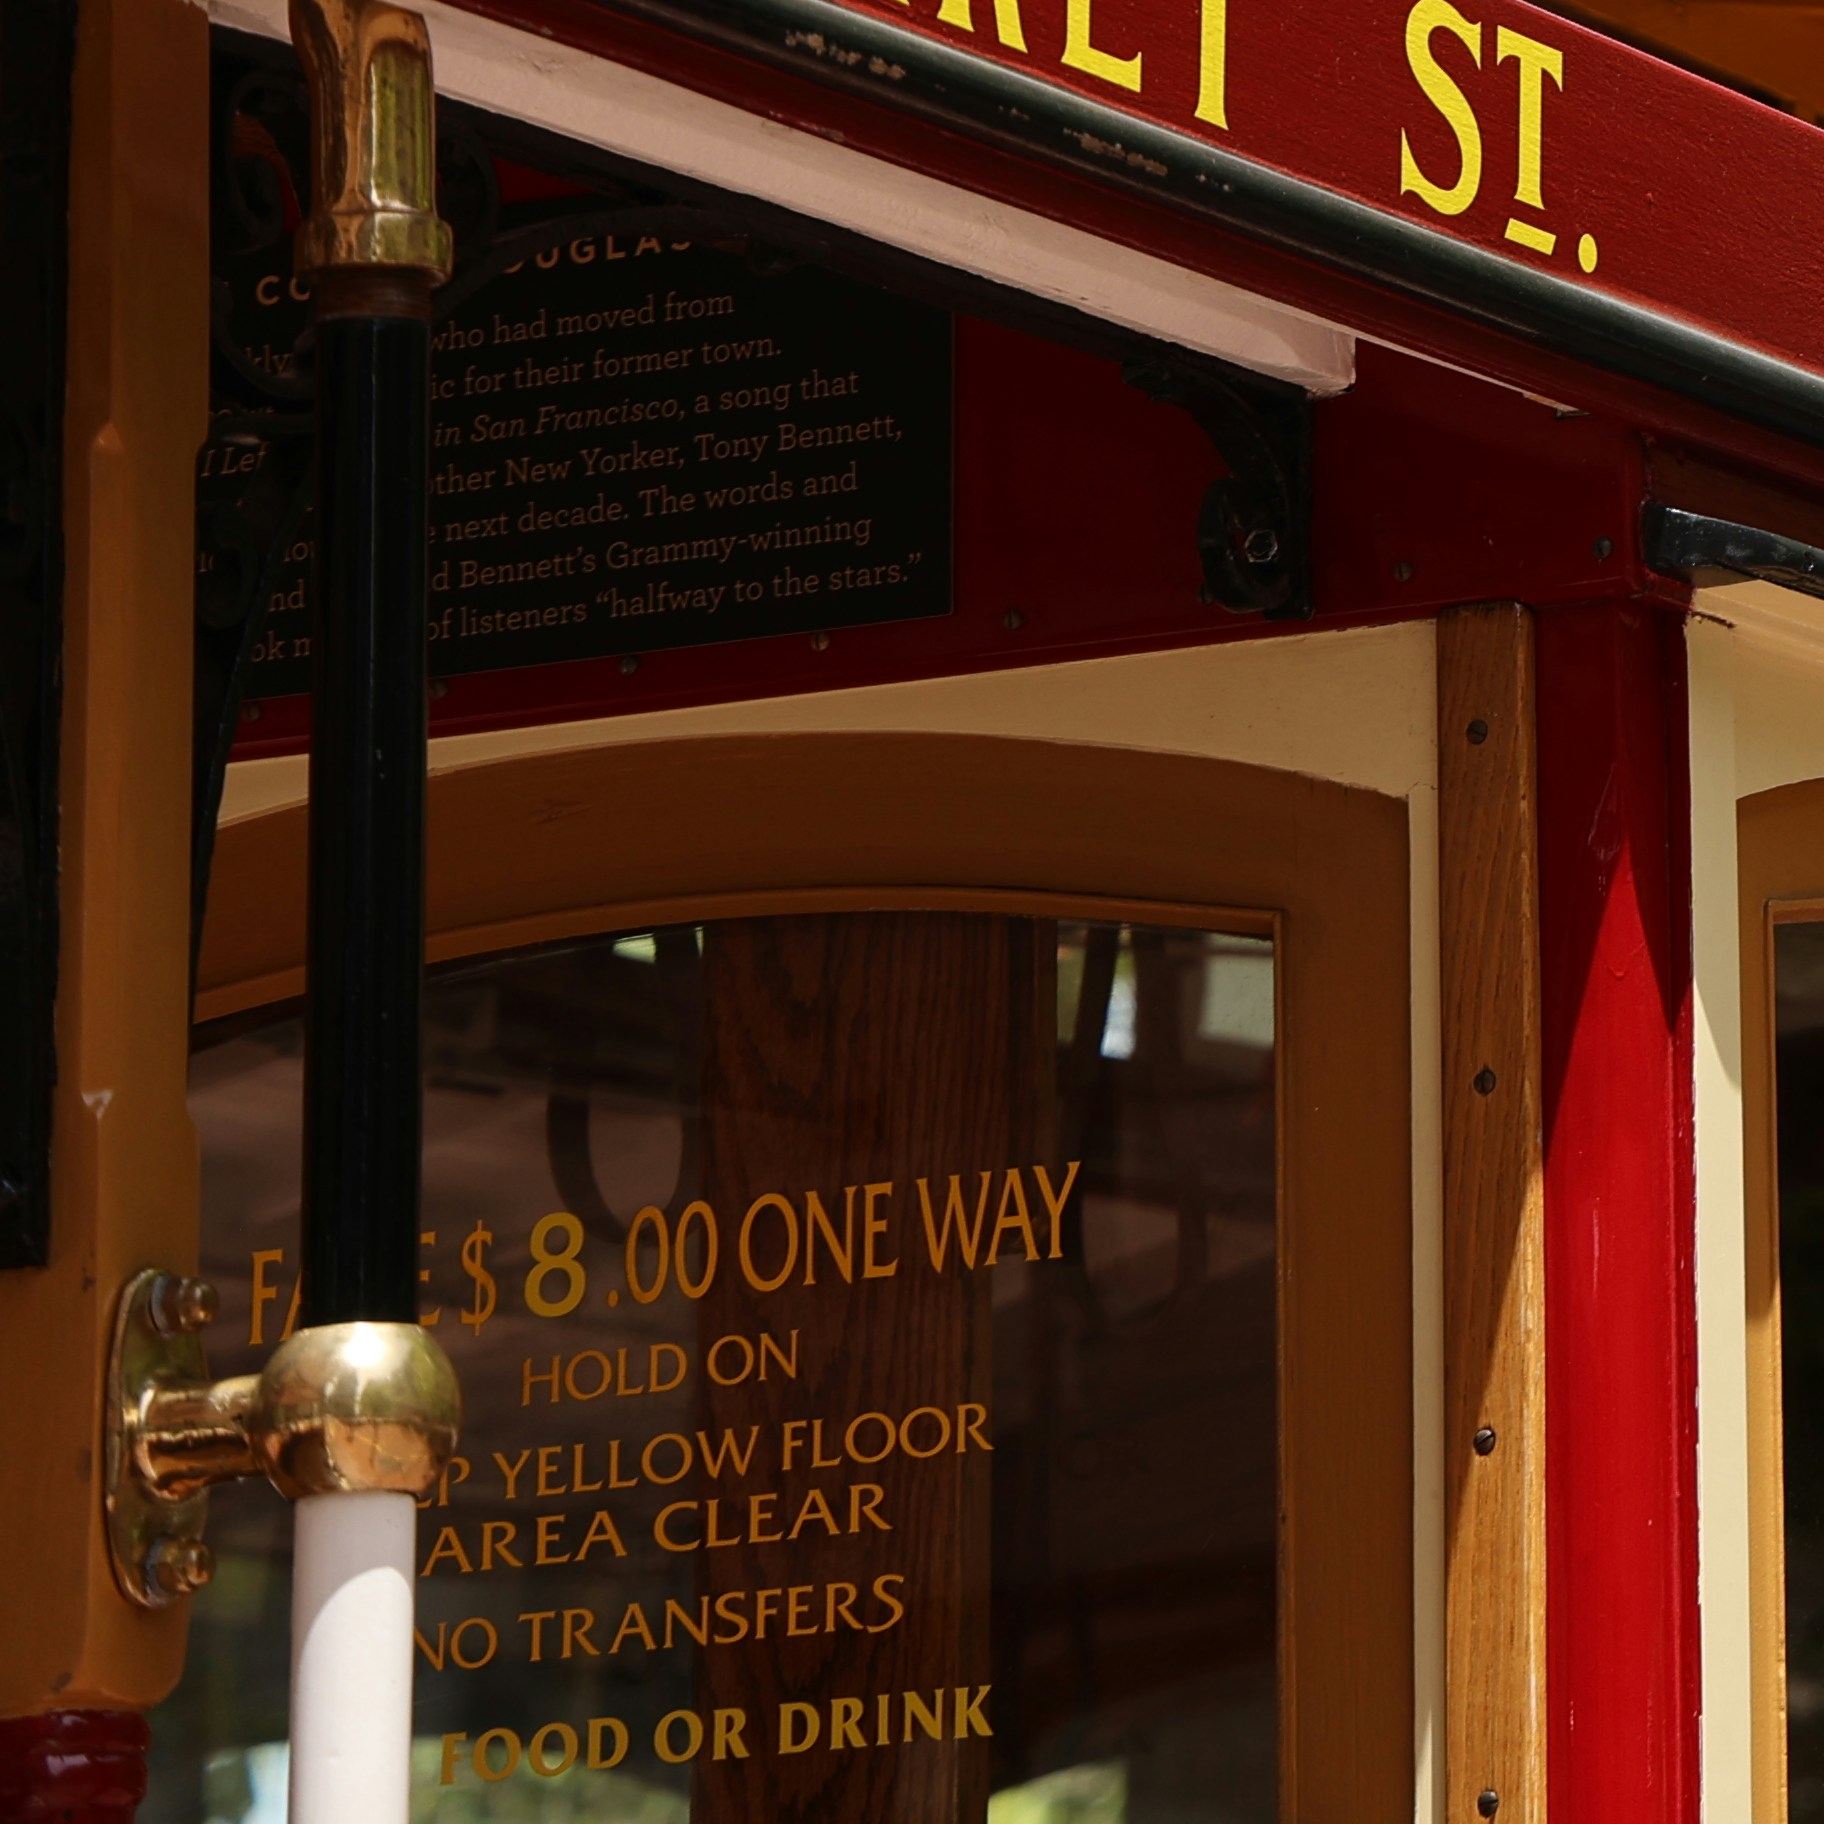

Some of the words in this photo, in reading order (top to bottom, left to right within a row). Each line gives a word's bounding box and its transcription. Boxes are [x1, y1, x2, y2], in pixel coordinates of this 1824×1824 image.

[493, 308, 547, 346] had
[556, 294, 656, 339] moved
[664, 291, 735, 324] from
[463, 364, 505, 398] for
[514, 354, 583, 390] their
[593, 349, 692, 380] former
[701, 337, 783, 366] town.
[435, 423, 461, 449] in
[470, 414, 526, 444] San
[534, 397, 685, 439] Francisco,
[694, 395, 710, 415] a
[719, 383, 791, 411] song
[800, 369, 859, 401] that
[504, 456, 572, 487] New
[579, 440, 685, 478] Yorker,
[694, 433, 769, 463] Tony
[777, 414, 903, 453] Bennett,
[444, 513, 509, 544] next
[518, 493, 629, 534] decade.
[639, 484, 696, 518] The
[705, 471, 793, 510] words
[803, 461, 858, 496] and
[606, 516, 872, 571] Grammy-winning
[460, 600, 587, 638] listeners
[734, 578, 764, 604] to
[772, 566, 820, 598] the
[739, 1182, 898, 1293] ONE
[917, 1161, 1081, 1274] WAY
[521, 1343, 687, 1406] HOLD
[707, 1329, 799, 1386] ON
[492, 1425, 759, 1500] YELLOW
[782, 1403, 994, 1472] FLOOR
[420, 1510, 628, 1576] AREA
[653, 1483, 893, 1552] CLEAR
[517, 1574, 905, 1662] TRANSFERS
[440, 1717, 630, 1786] FOOD
[654, 1708, 750, 1764] OR
[778, 1684, 994, 1754] DRINK
